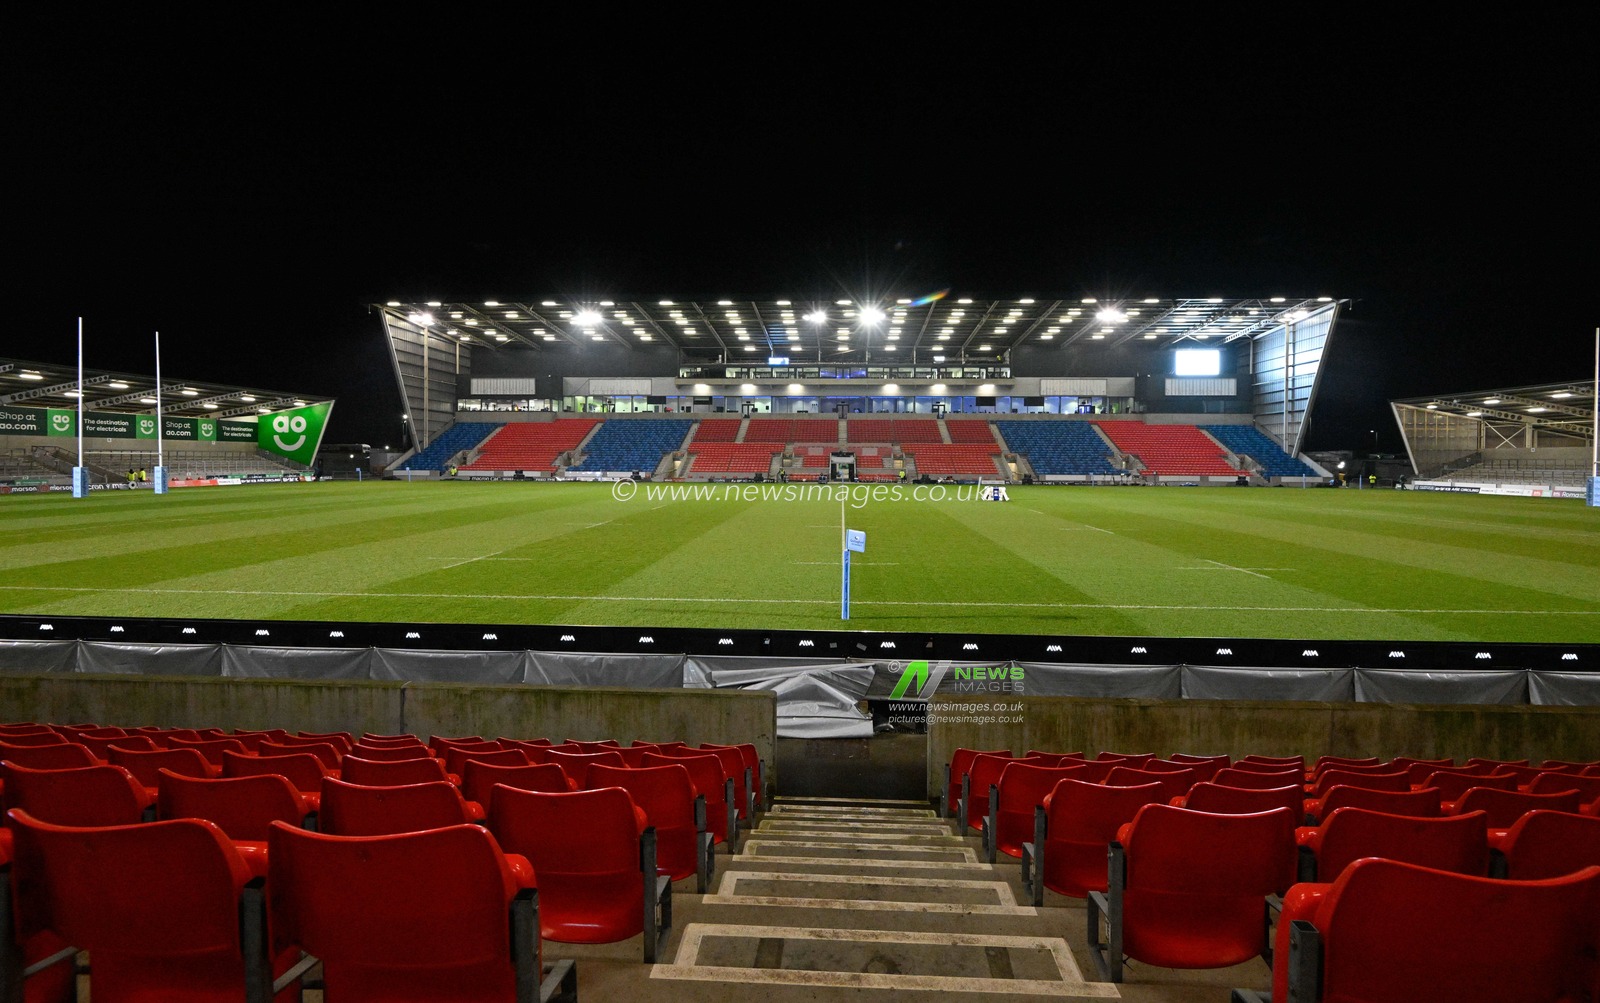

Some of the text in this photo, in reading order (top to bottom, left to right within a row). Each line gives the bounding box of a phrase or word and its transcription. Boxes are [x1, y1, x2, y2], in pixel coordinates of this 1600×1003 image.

[0, 411, 36, 421] Shop at
[52, 414, 70, 424] ao
[0, 422, 37, 431] ao.com
[140, 419, 154, 428] ao
[165, 421, 182, 429] Shop
[272, 415, 307, 433] ao
